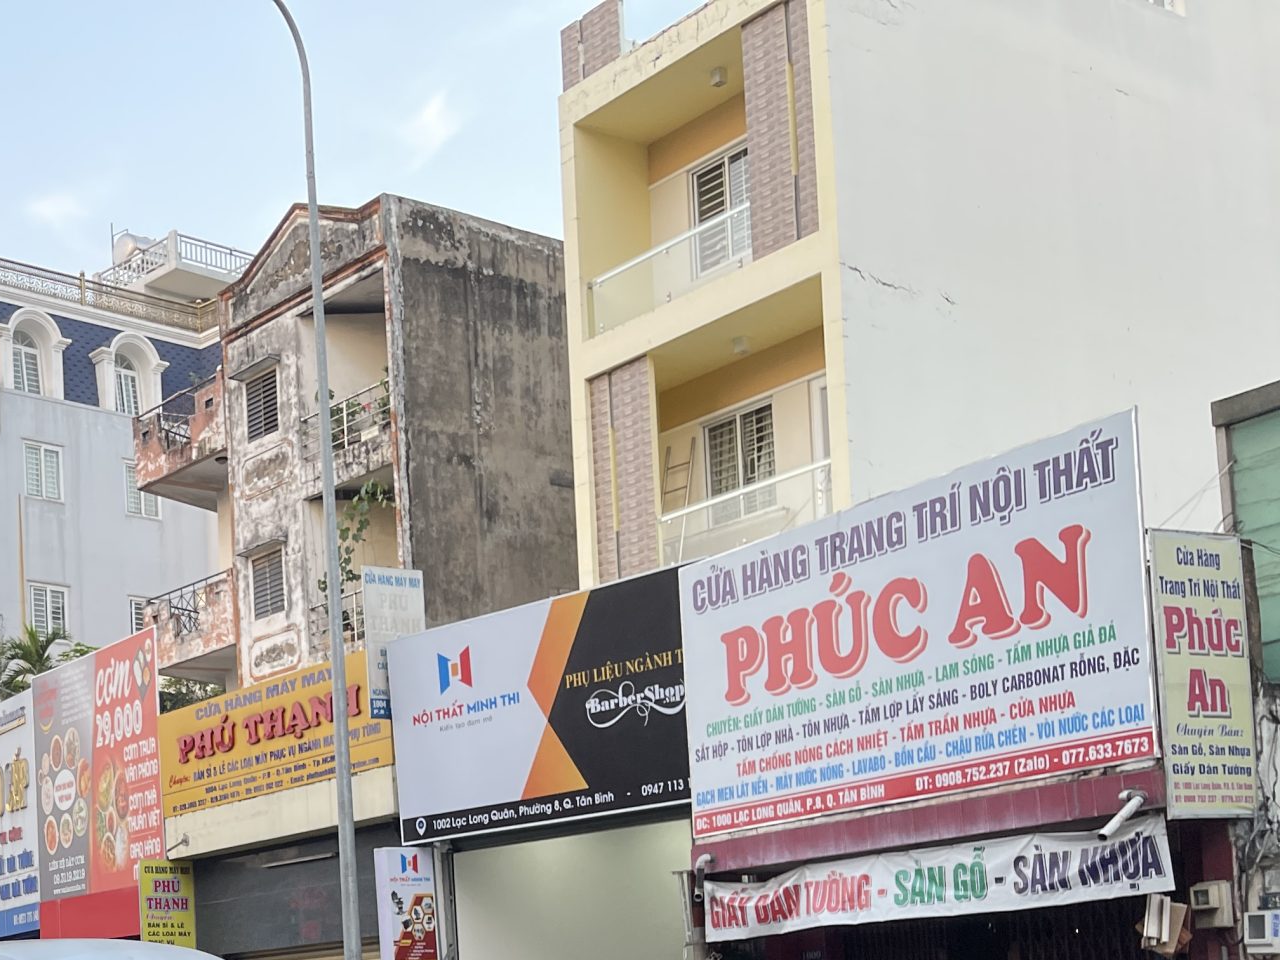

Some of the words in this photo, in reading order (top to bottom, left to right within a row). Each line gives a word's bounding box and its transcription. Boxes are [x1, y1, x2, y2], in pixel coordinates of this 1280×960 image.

[692, 564, 739, 614] CỬA
[742, 550, 809, 596] HÀNG
[815, 510, 907, 574] TRANG
[913, 481, 962, 543] TRÍ
[969, 465, 1027, 526] NỘI
[1033, 428, 1118, 504] THẤT
[1159, 576, 1186, 598] Trang
[1203, 579, 1219, 602] Nội
[720, 571, 929, 707] PHÚC
[948, 524, 1091, 648] AN
[1163, 605, 1244, 658] Phúc
[224, 691, 263, 712] HÀNG
[265, 676, 298, 699] MÁY
[301, 667, 333, 688] MAY
[565, 669, 590, 688] PHỤ
[593, 660, 623, 682] LIỆU
[625, 651, 672, 675] NGÀNH
[743, 706, 763, 728] GIẤY
[826, 688, 846, 709] SÀN
[871, 677, 893, 698] SÀN
[896, 669, 925, 692] NHỰA
[935, 662, 959, 683] LAM
[963, 653, 995, 676] SÓNG
[1006, 640, 1032, 665] TẤM
[1036, 633, 1070, 659] NHỰA
[1073, 623, 1095, 650] GIẢ
[1098, 619, 1117, 644] ĐÁ
[1187, 668, 1232, 719] An
[412, 709, 433, 728] NỘI
[435, 699, 464, 721] THẤT
[466, 696, 498, 714] MINH
[500, 691, 520, 706] THI
[775, 723, 794, 746] NHÀ
[802, 718, 821, 739] TÔN
[823, 711, 850, 735] NHỰA
[858, 703, 881, 726] TẤM
[883, 700, 903, 723] LỢP
[928, 687, 959, 711] SÁNG
[970, 680, 998, 701] BOLY
[1002, 663, 1066, 694] CARBONAT
[1113, 646, 1140, 672] ĐẶC
[96, 699, 142, 748] 29,000
[177, 714, 236, 764] PHÚ
[736, 755, 756, 778] TẤM
[759, 750, 792, 773] CHỐNG
[794, 744, 823, 766] NÓNG
[825, 738, 853, 759] CÁCH
[857, 729, 889, 753] NHIỆT
[900, 719, 925, 743] TẤM
[963, 705, 998, 732] NHỰA
[1009, 695, 1035, 720] CỬA
[1039, 689, 1076, 714] NHỰA
[852, 754, 886, 775] LAVABO
[1092, 706, 1115, 729] CÁC
[1120, 703, 1145, 726] LOẠI
[432, 817, 451, 830] 1002
[452, 815, 467, 829] Lạc
[469, 811, 489, 828] Long
[490, 807, 517, 822] Quân,
[519, 801, 553, 818] Phường
[563, 798, 574, 810] Q.
[576, 795, 593, 807] Tân
[595, 791, 615, 804] Bình
[641, 783, 664, 796] 0947
[667, 780, 685, 794] 113
[711, 813, 732, 828] 1000
[733, 809, 750, 826] LẠC
[751, 805, 775, 820] LONG
[838, 788, 858, 804] TÂN
[860, 784, 885, 801] BÌNH
[935, 761, 1010, 788] 0908.752.237
[1014, 754, 1050, 775] (Zalo)
[1061, 736, 1149, 766] 077.633.7673
[153, 876, 180, 893] PHÚ
[893, 858, 946, 907] SÀN
[953, 846, 989, 902] GỖ
[1013, 844, 1072, 895] SÀN
[1078, 831, 1166, 891] NHỰA
